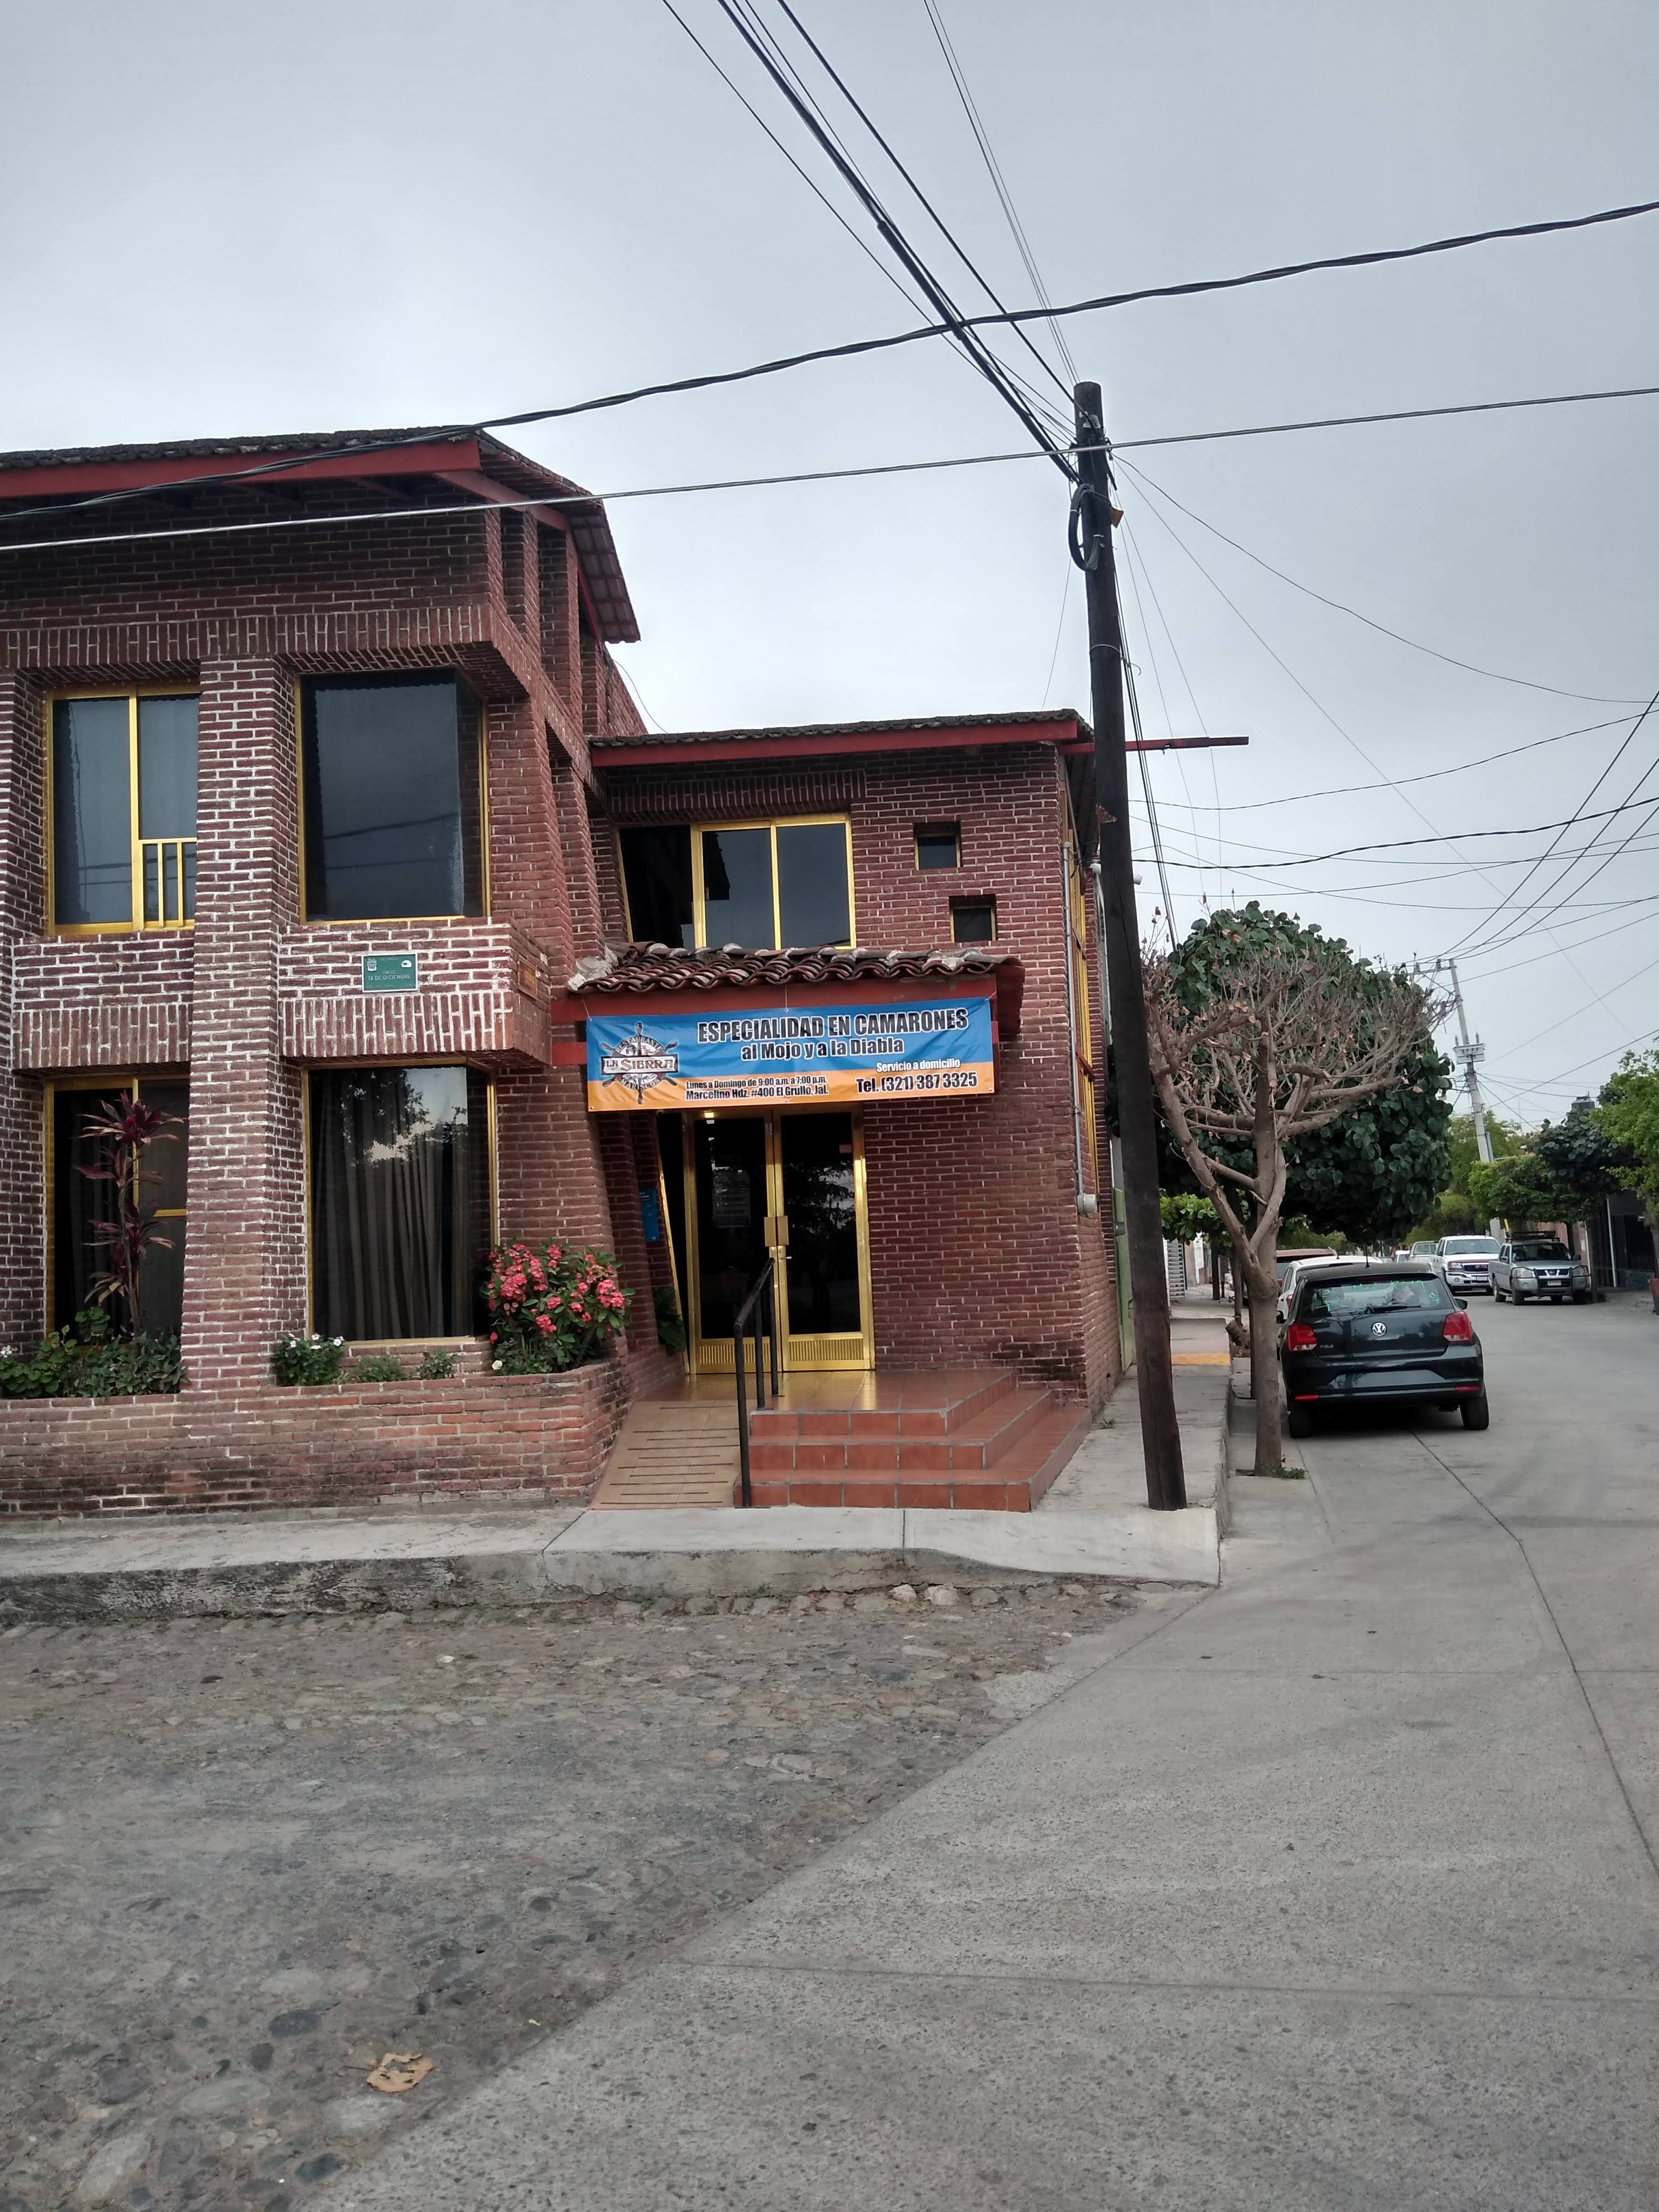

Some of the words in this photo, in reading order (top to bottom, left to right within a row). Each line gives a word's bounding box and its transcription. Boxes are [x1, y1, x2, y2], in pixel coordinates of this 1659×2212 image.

[698, 1016, 824, 1043] ESPECIALIDAD
[828, 1015, 850, 1037] EN
[855, 1008, 968, 1035] CAMARONES
[616, 1037, 663, 1053] RESTAURANTE
[741, 1044, 757, 1060] al
[760, 1042, 801, 1060] Mojo
[805, 1043, 813, 1058] y
[817, 1043, 827, 1056] a
[831, 1040, 846, 1056] la
[850, 1037, 904, 1055] Diabla
[621, 1059, 673, 1071] SIERRA
[876, 1062, 912, 1073] Servicio
[920, 1058, 960, 1070] domicilio
[622, 1079, 659, 1090] MARISCOS
[686, 1081, 707, 1089] Lunes
[714, 1080, 746, 1089] Domingo
[747, 1078, 757, 1087] de
[758, 1078, 774, 1086] 9:00
[796, 1076, 811, 1084] 7:00
[812, 1076, 827, 1084] p.m.
[857, 1078, 879, 1092] Tel.
[881, 1076, 913, 1091] (321)
[917, 1074, 940, 1090] 387
[942, 1073, 977, 1088] 3325
[686, 1090, 730, 1100] Marcelino
[732, 1089, 749, 1098] Hdz.
[751, 1087, 774, 1097] #400
[777, 1087, 783, 1096] El
[785, 1085, 813, 1096] Grullo,
[814, 1085, 828, 1095] Jal.
